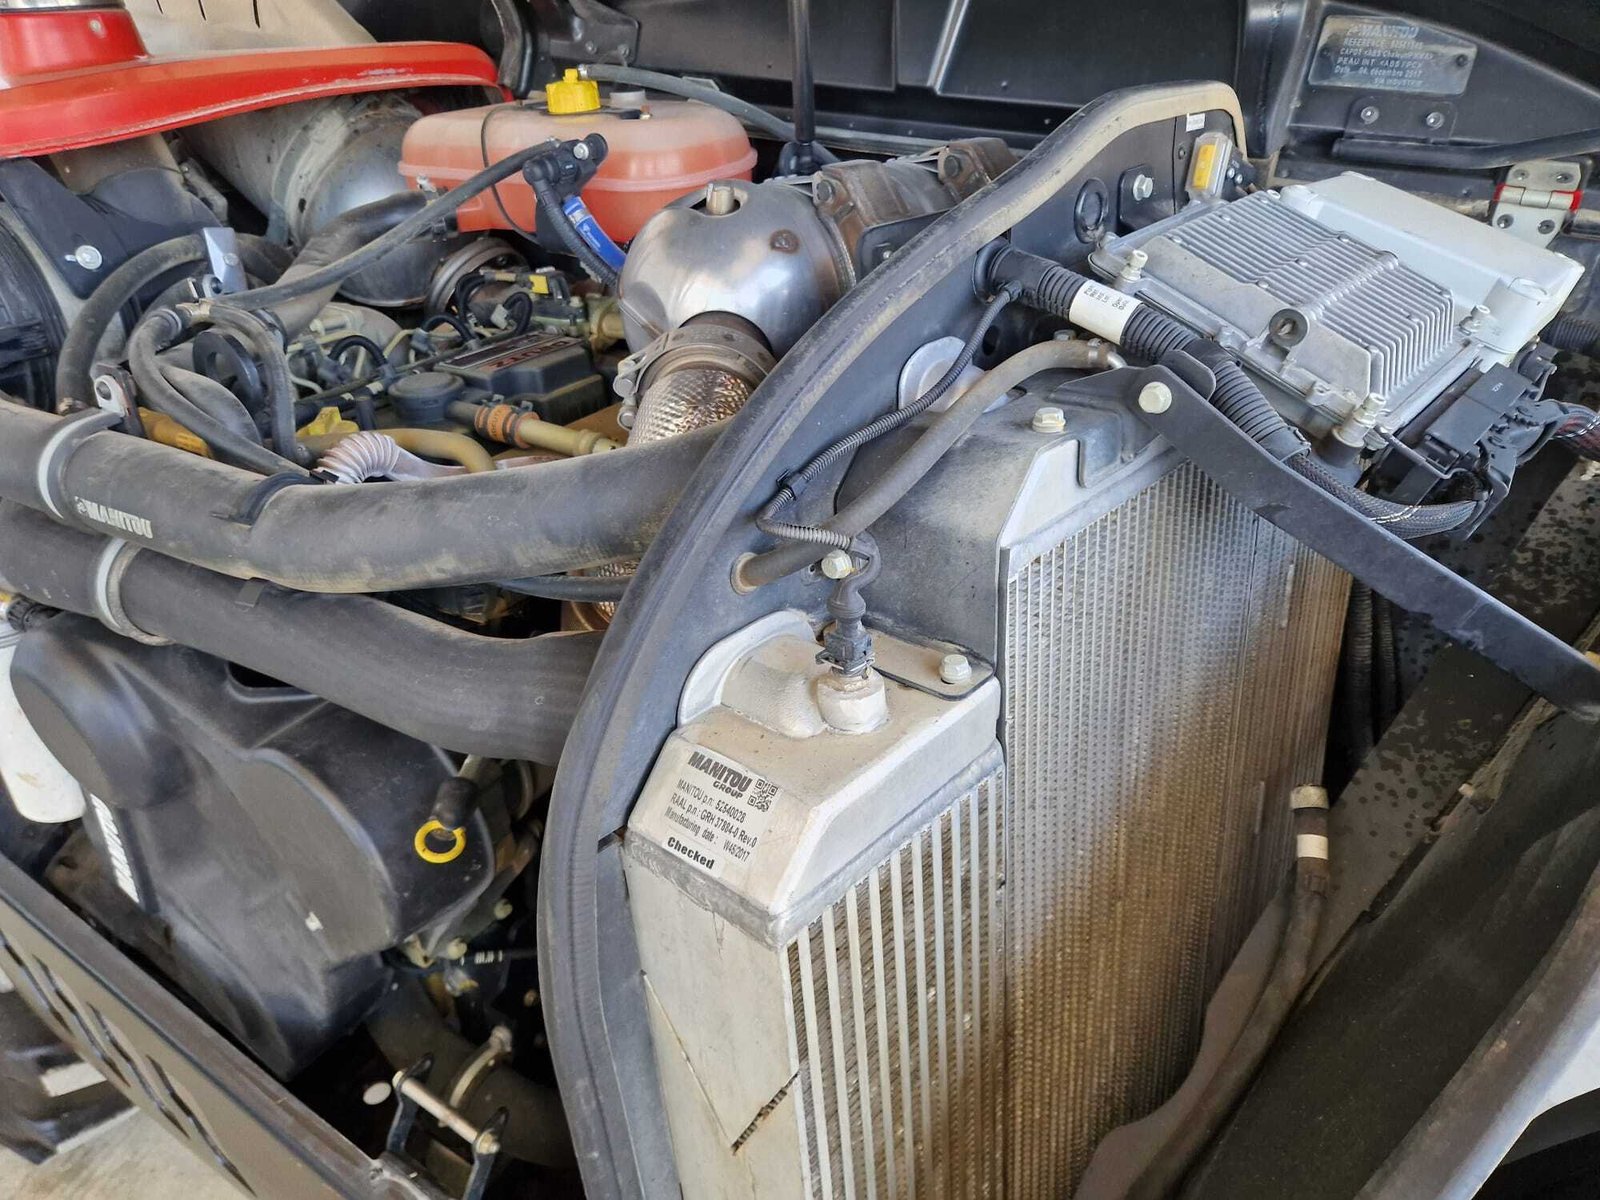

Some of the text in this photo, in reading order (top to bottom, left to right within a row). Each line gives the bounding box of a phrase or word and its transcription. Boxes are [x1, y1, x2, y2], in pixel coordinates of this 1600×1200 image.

[80, 498, 153, 539] MANITOU
[688, 751, 753, 793] MANITOU
[677, 779, 704, 800] MANITOU
[715, 800, 746, 823] 52540028
[712, 780, 743, 799] GROUP
[664, 806, 701, 837] Manufacturing
[671, 793, 687, 810] RAAL
[700, 809, 715, 825] GRH
[667, 836, 715, 870] Checked
